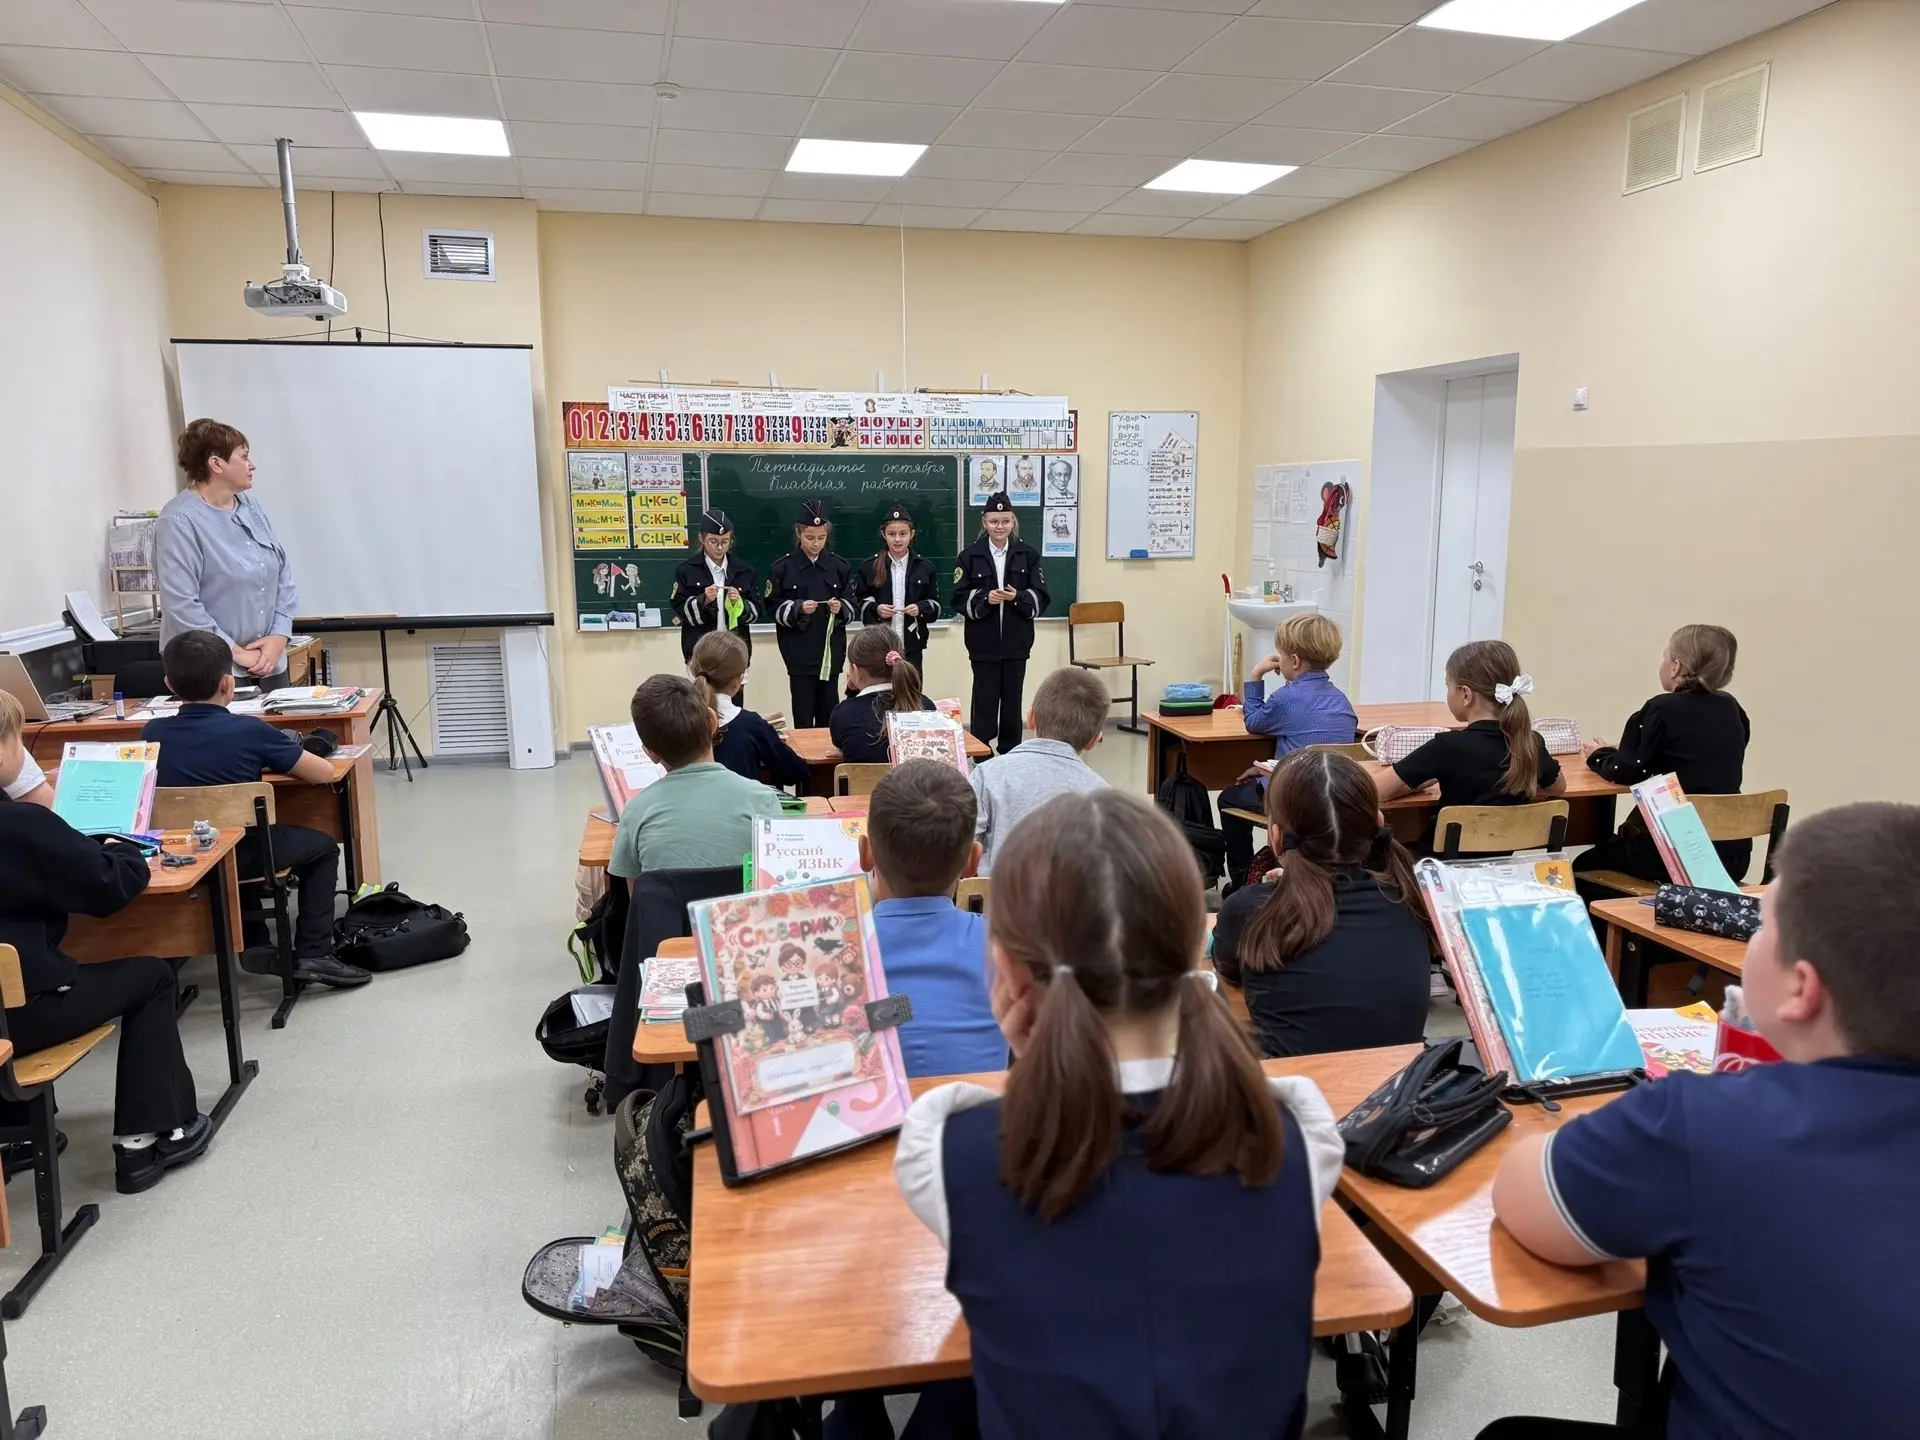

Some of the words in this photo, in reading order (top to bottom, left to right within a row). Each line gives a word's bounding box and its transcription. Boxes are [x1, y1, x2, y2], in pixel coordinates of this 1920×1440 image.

[570, 409, 584, 441] 0
[584, 410, 595, 440] 1
[597, 410, 610, 441] 2
[617, 411, 631, 442] 3
[638, 411, 650, 442] 4
[664, 412, 677, 442] 5
[691, 413, 704, 442] 6
[724, 413, 734, 443] 7
[754, 415, 766, 443] 8
[791, 415, 803, 444] 9
[634, 465, 641, 474] 2
[651, 465, 658, 474] 3
[670, 465, 678, 474] 6
[748, 455, 866, 481] Пятнадцатое
[882, 460, 947, 475] октября
[768, 474, 848, 491] Классная
[861, 477, 919, 494] работа
[615, 747, 643, 757] Русски
[764, 843, 824, 859] Русский
[771, 1115, 785, 1139] 1
[647, 1222, 678, 1240] MAXPOWER
